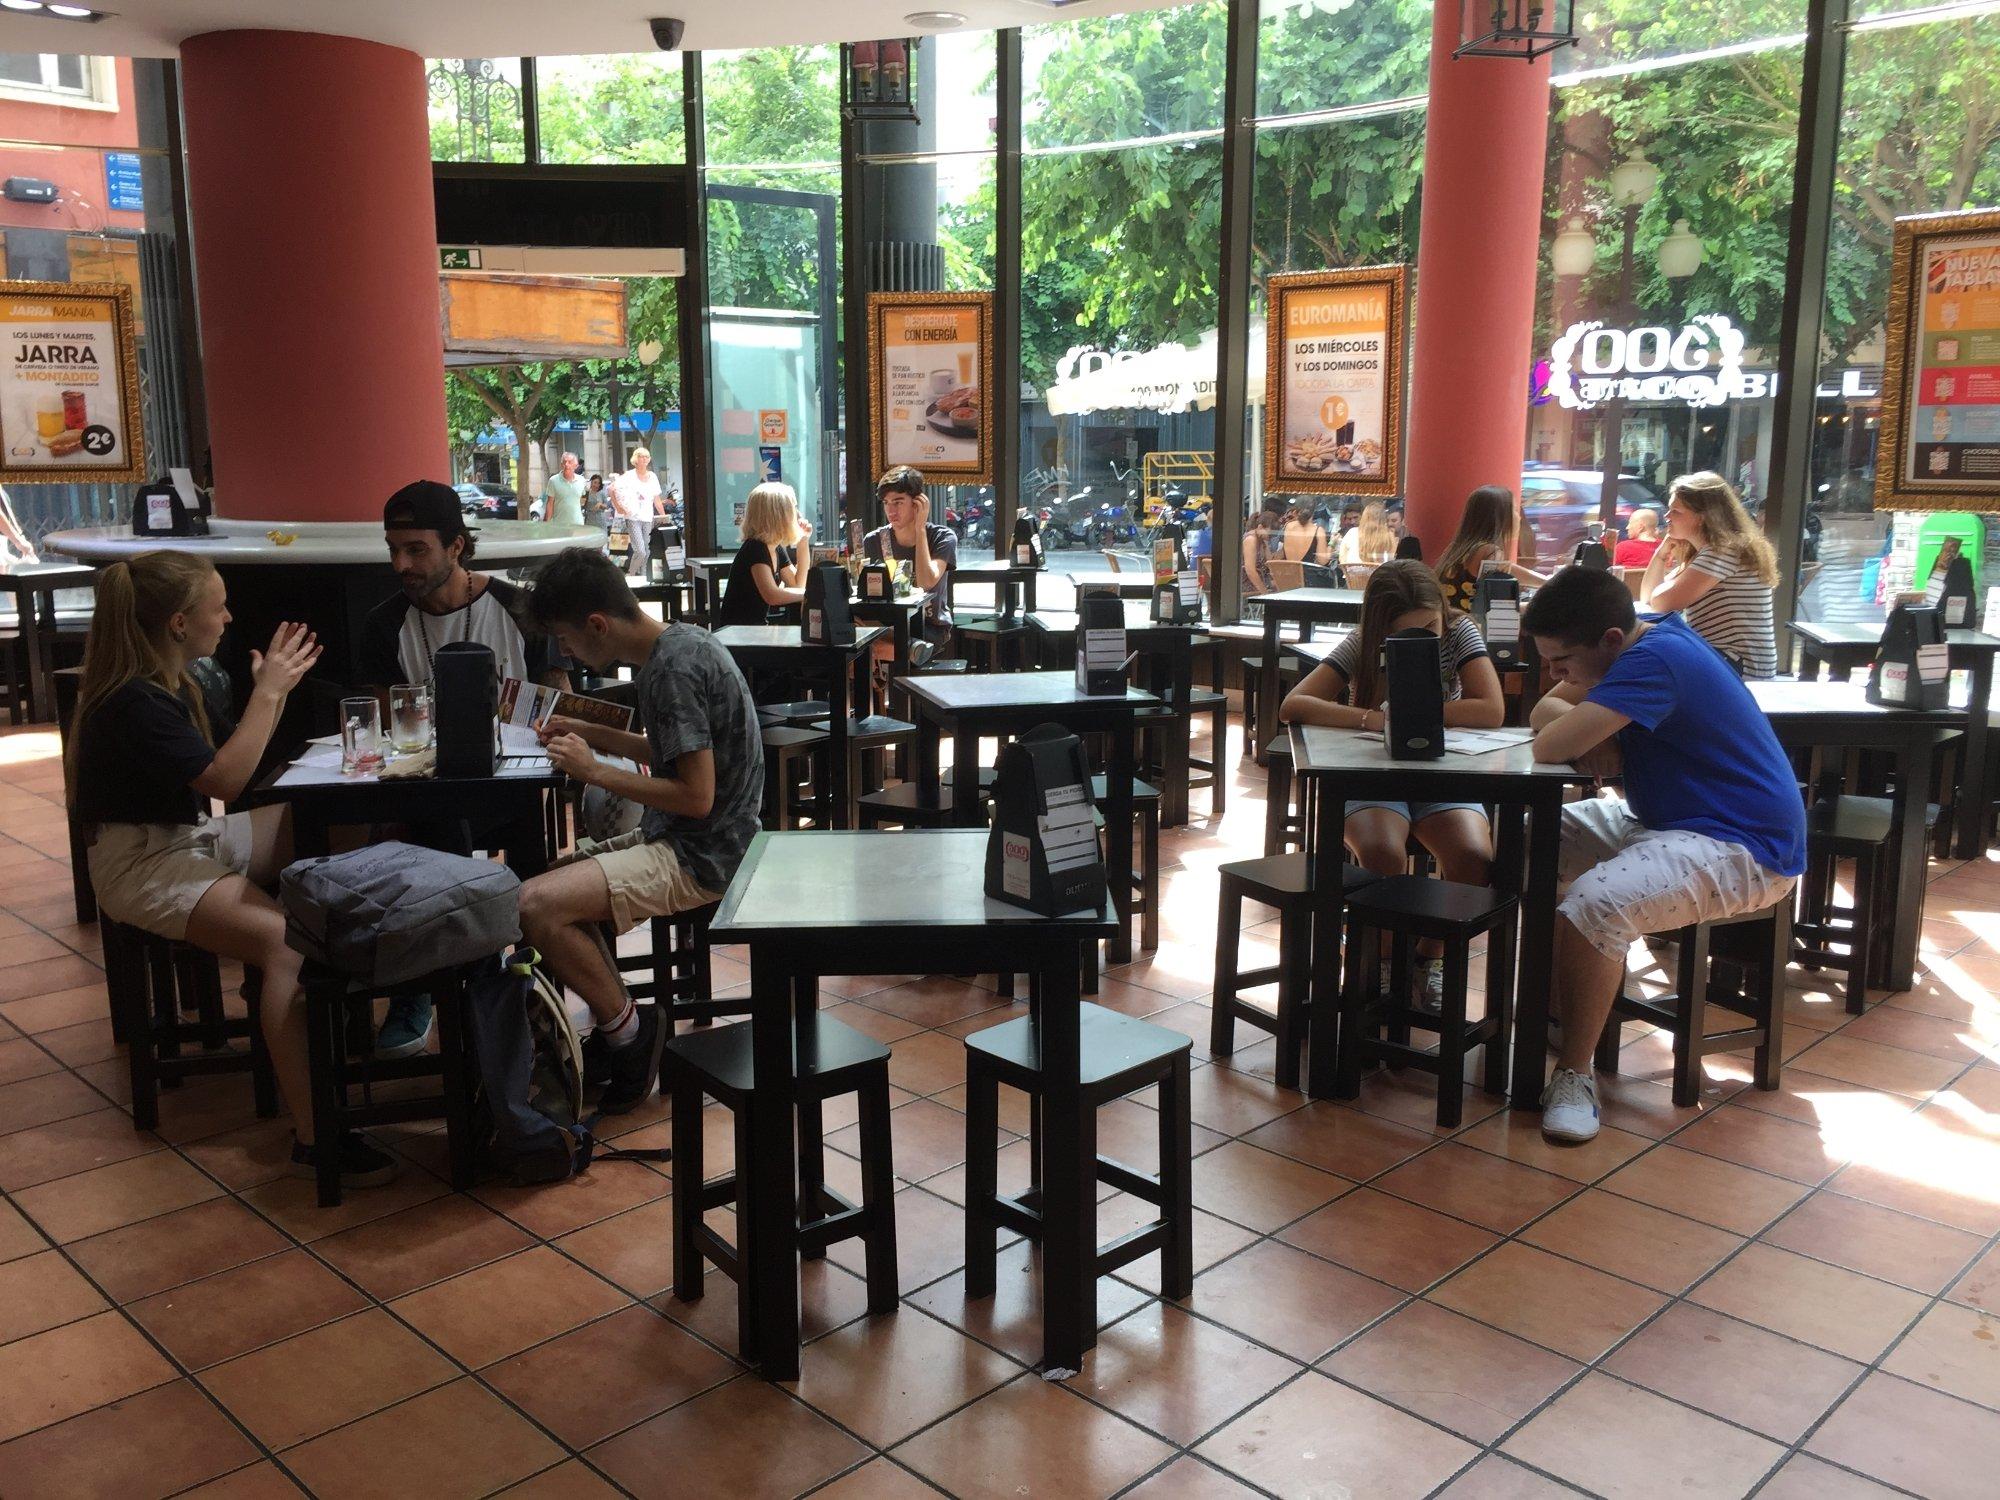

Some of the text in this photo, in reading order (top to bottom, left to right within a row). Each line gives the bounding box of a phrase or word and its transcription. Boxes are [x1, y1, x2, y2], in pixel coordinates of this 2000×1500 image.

[1289, 297, 1385, 325] EUROMANÍA
[12, 331, 29, 339] LOS
[904, 324, 958, 341] CON ENERGÍA
[14, 344, 98, 364] JARRA
[1295, 339, 1379, 355] LOS MIÉRCOLES
[1295, 360, 1379, 372] Y LOS DOMINGOS
[25, 371, 100, 381] MONTADITO
[87, 432, 111, 449] 2€
